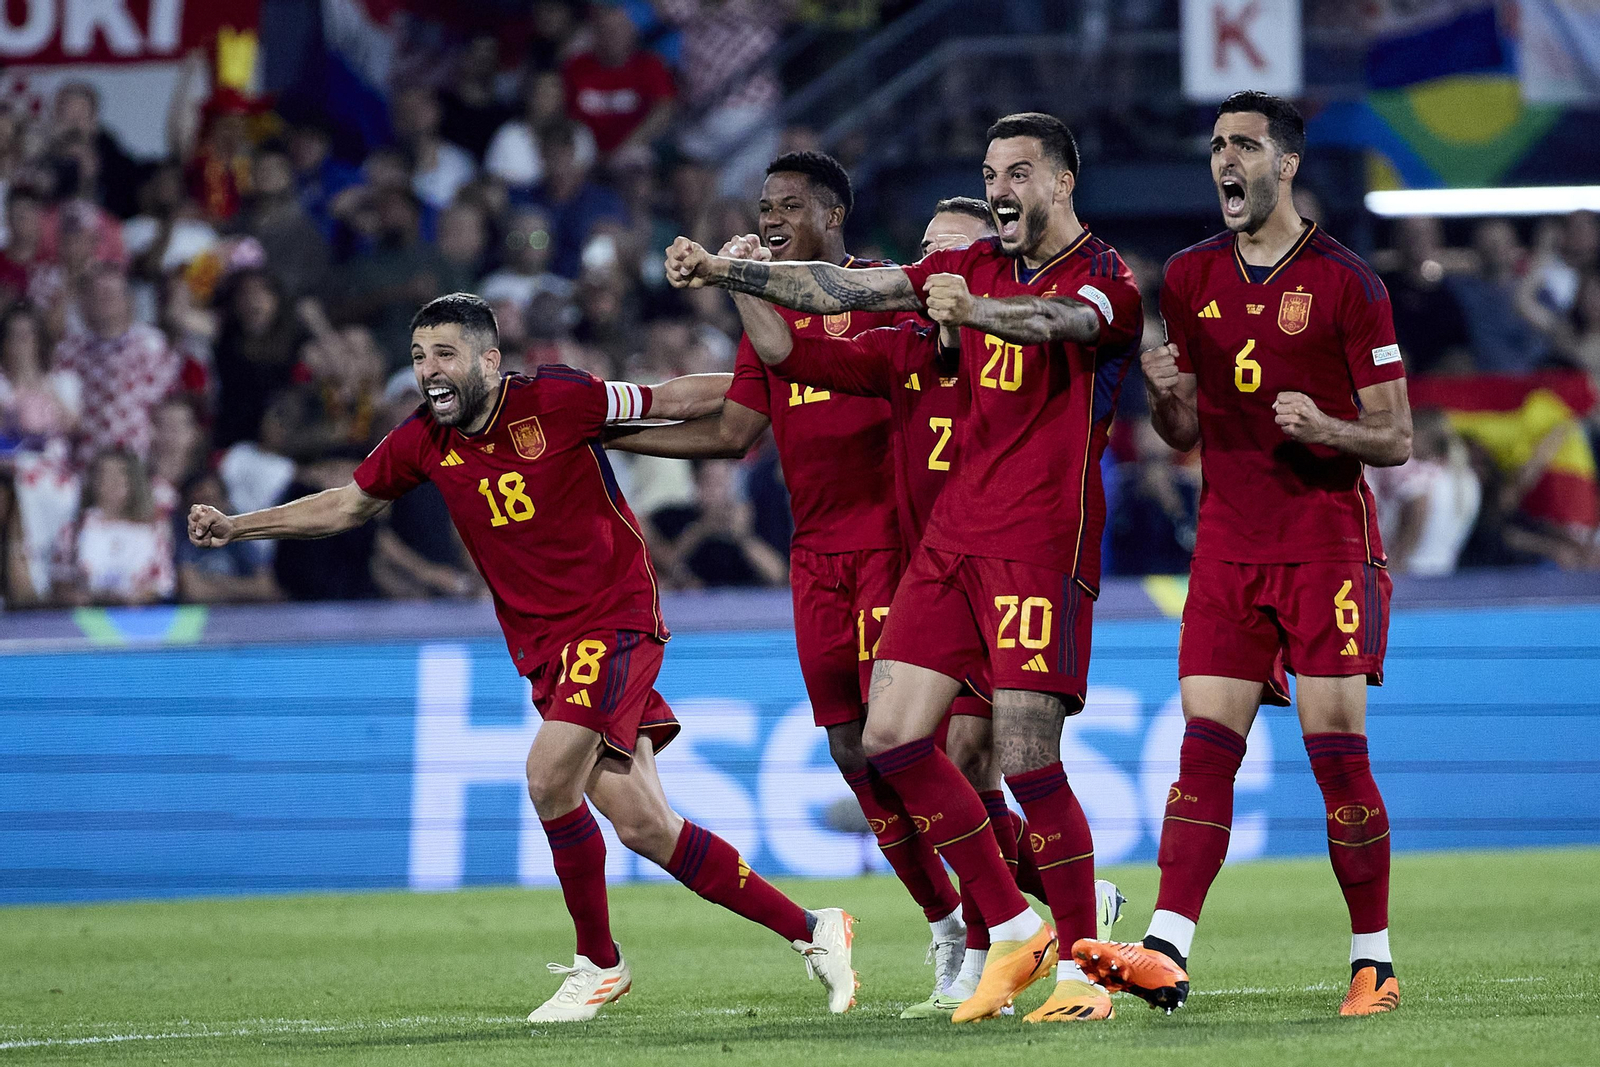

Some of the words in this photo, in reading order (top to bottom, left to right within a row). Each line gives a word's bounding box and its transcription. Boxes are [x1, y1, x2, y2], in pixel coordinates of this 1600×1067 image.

[1211, 0, 1268, 73] K
[980, 334, 1023, 392] 20
[1234, 339, 1262, 393] 6
[928, 417, 953, 472] 2
[478, 471, 536, 528] 18
[994, 595, 1053, 650] 20
[1334, 580, 1360, 634] 6
[558, 639, 607, 686] 18
